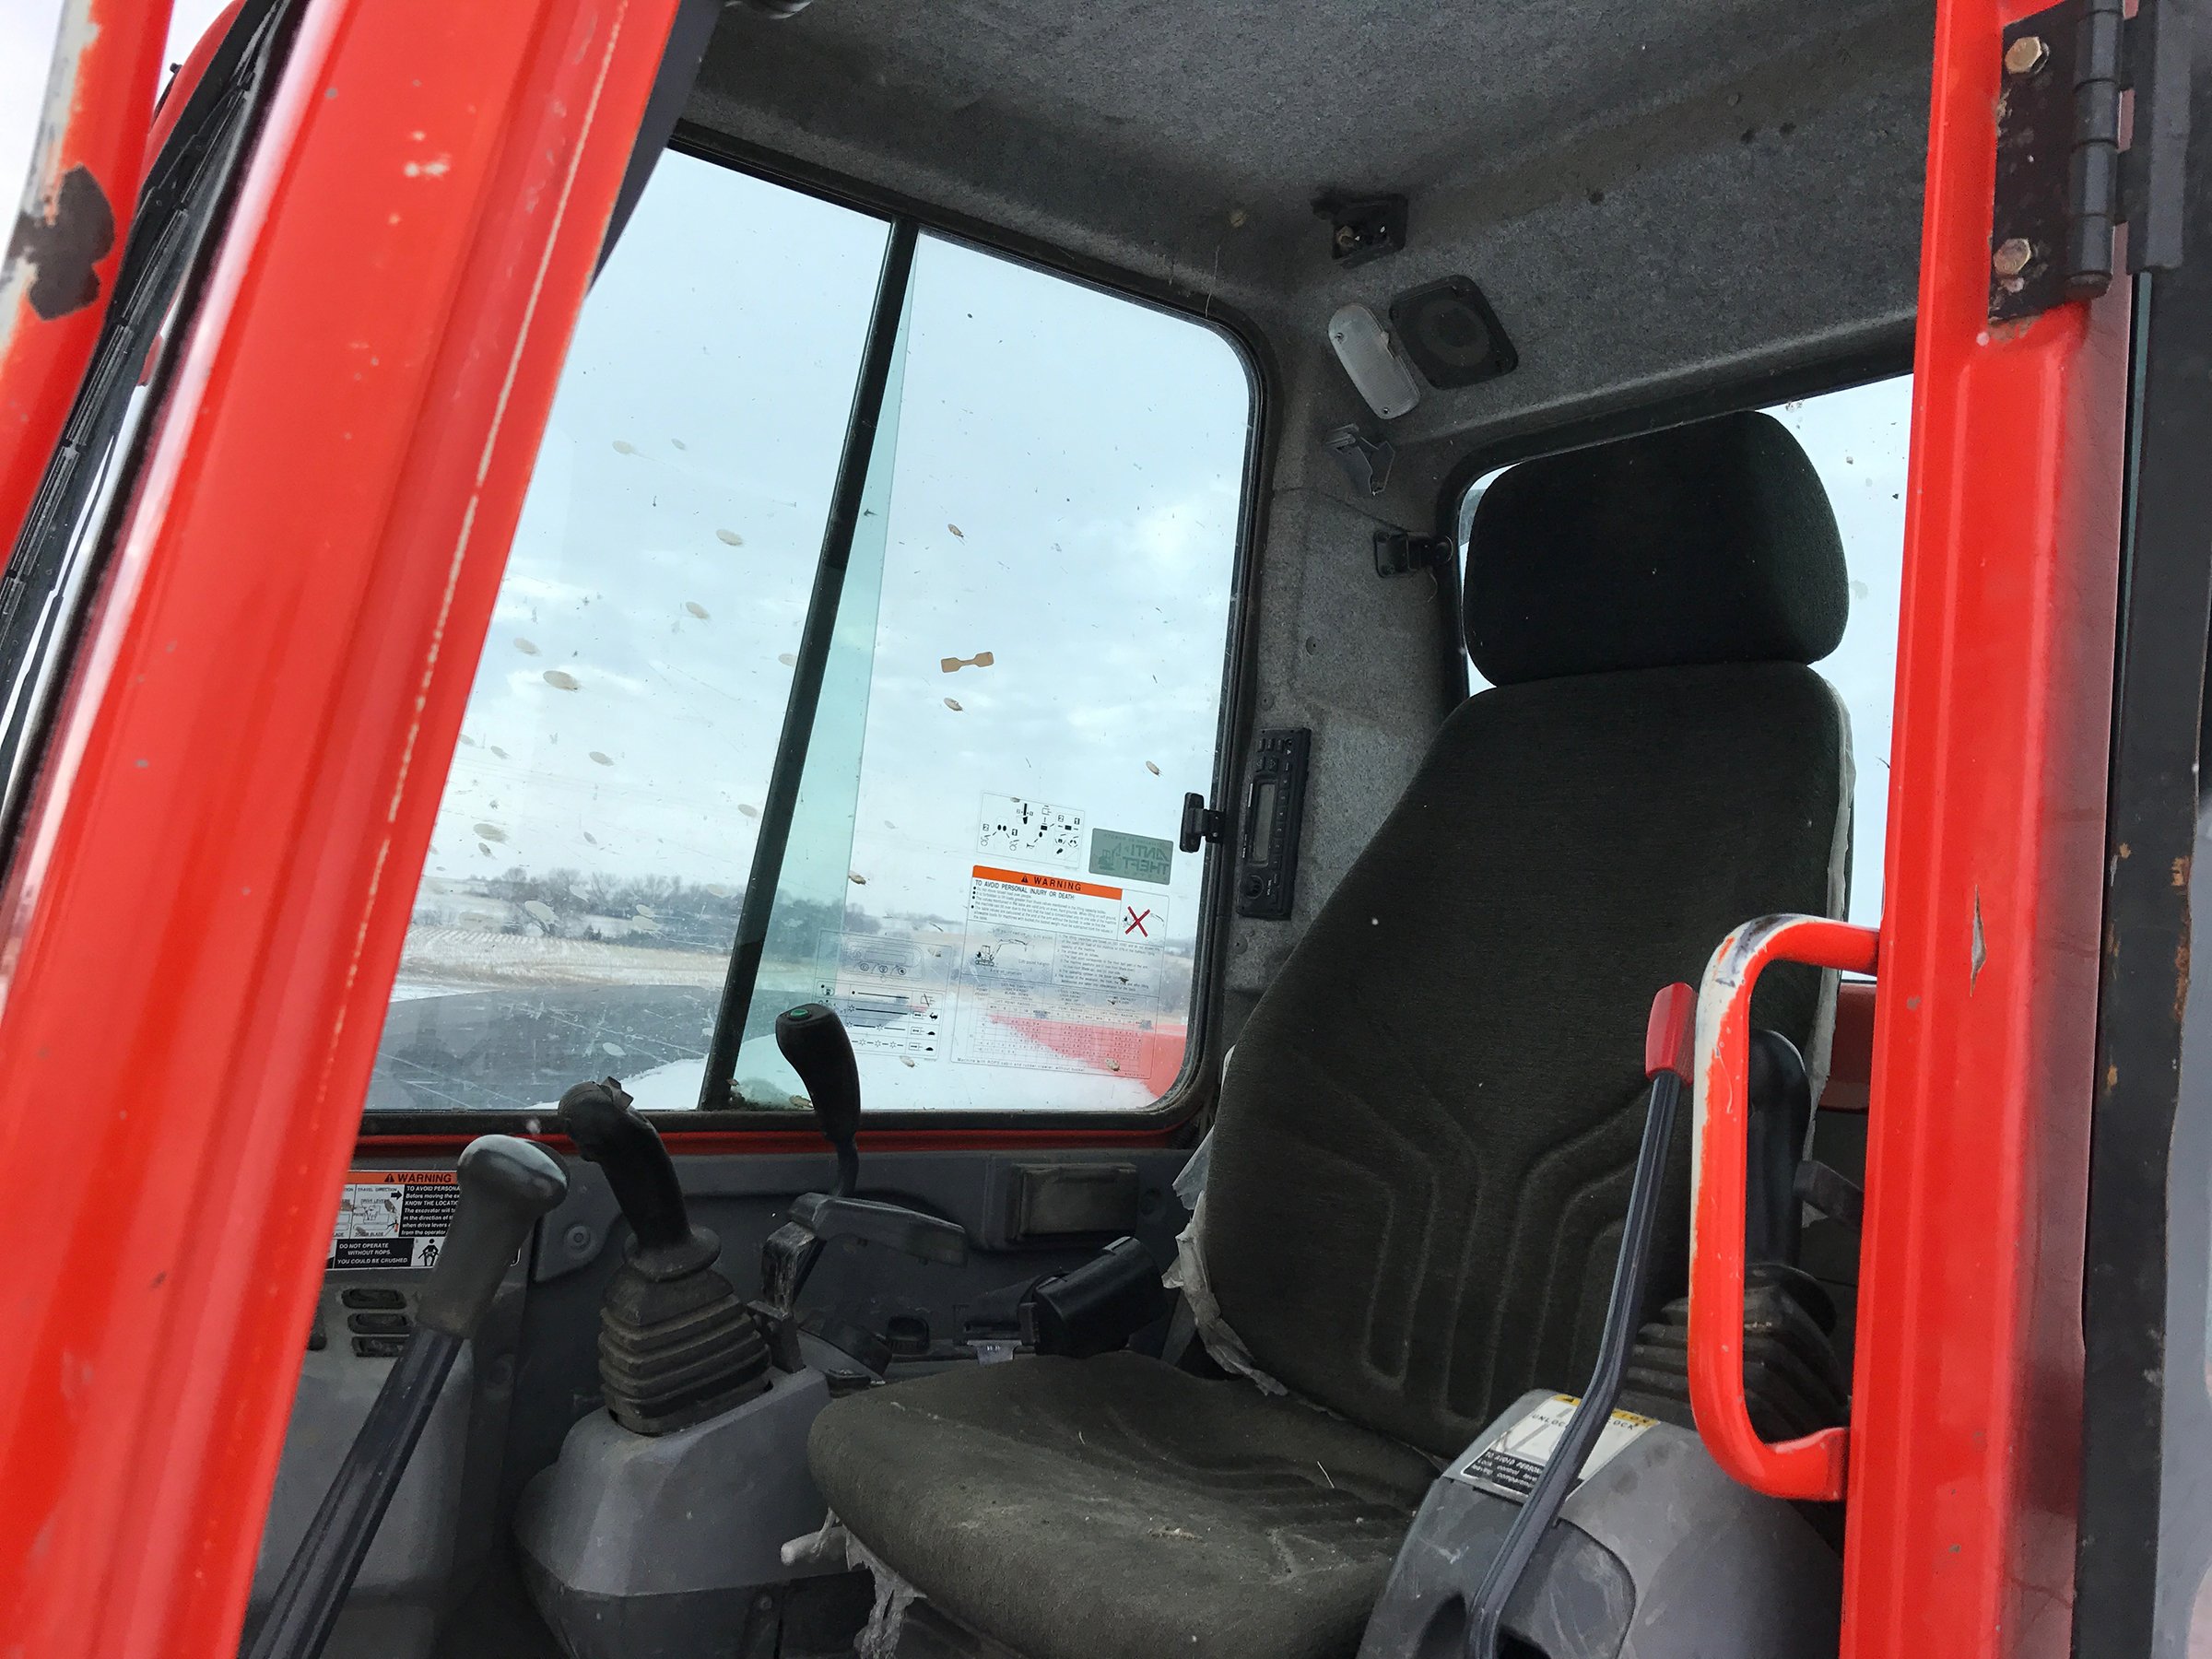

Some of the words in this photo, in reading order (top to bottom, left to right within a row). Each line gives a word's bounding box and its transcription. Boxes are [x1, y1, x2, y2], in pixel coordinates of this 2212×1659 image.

[1001, 883, 1028, 893] PERSONAL
[1030, 888, 1047, 896] INJURY
[1033, 876, 1082, 891] WARNING
[397, 1173, 452, 1182] WARNING
[1532, 1413, 1568, 1428] UNLOC
[1494, 1454, 1516, 1465] AVOID
